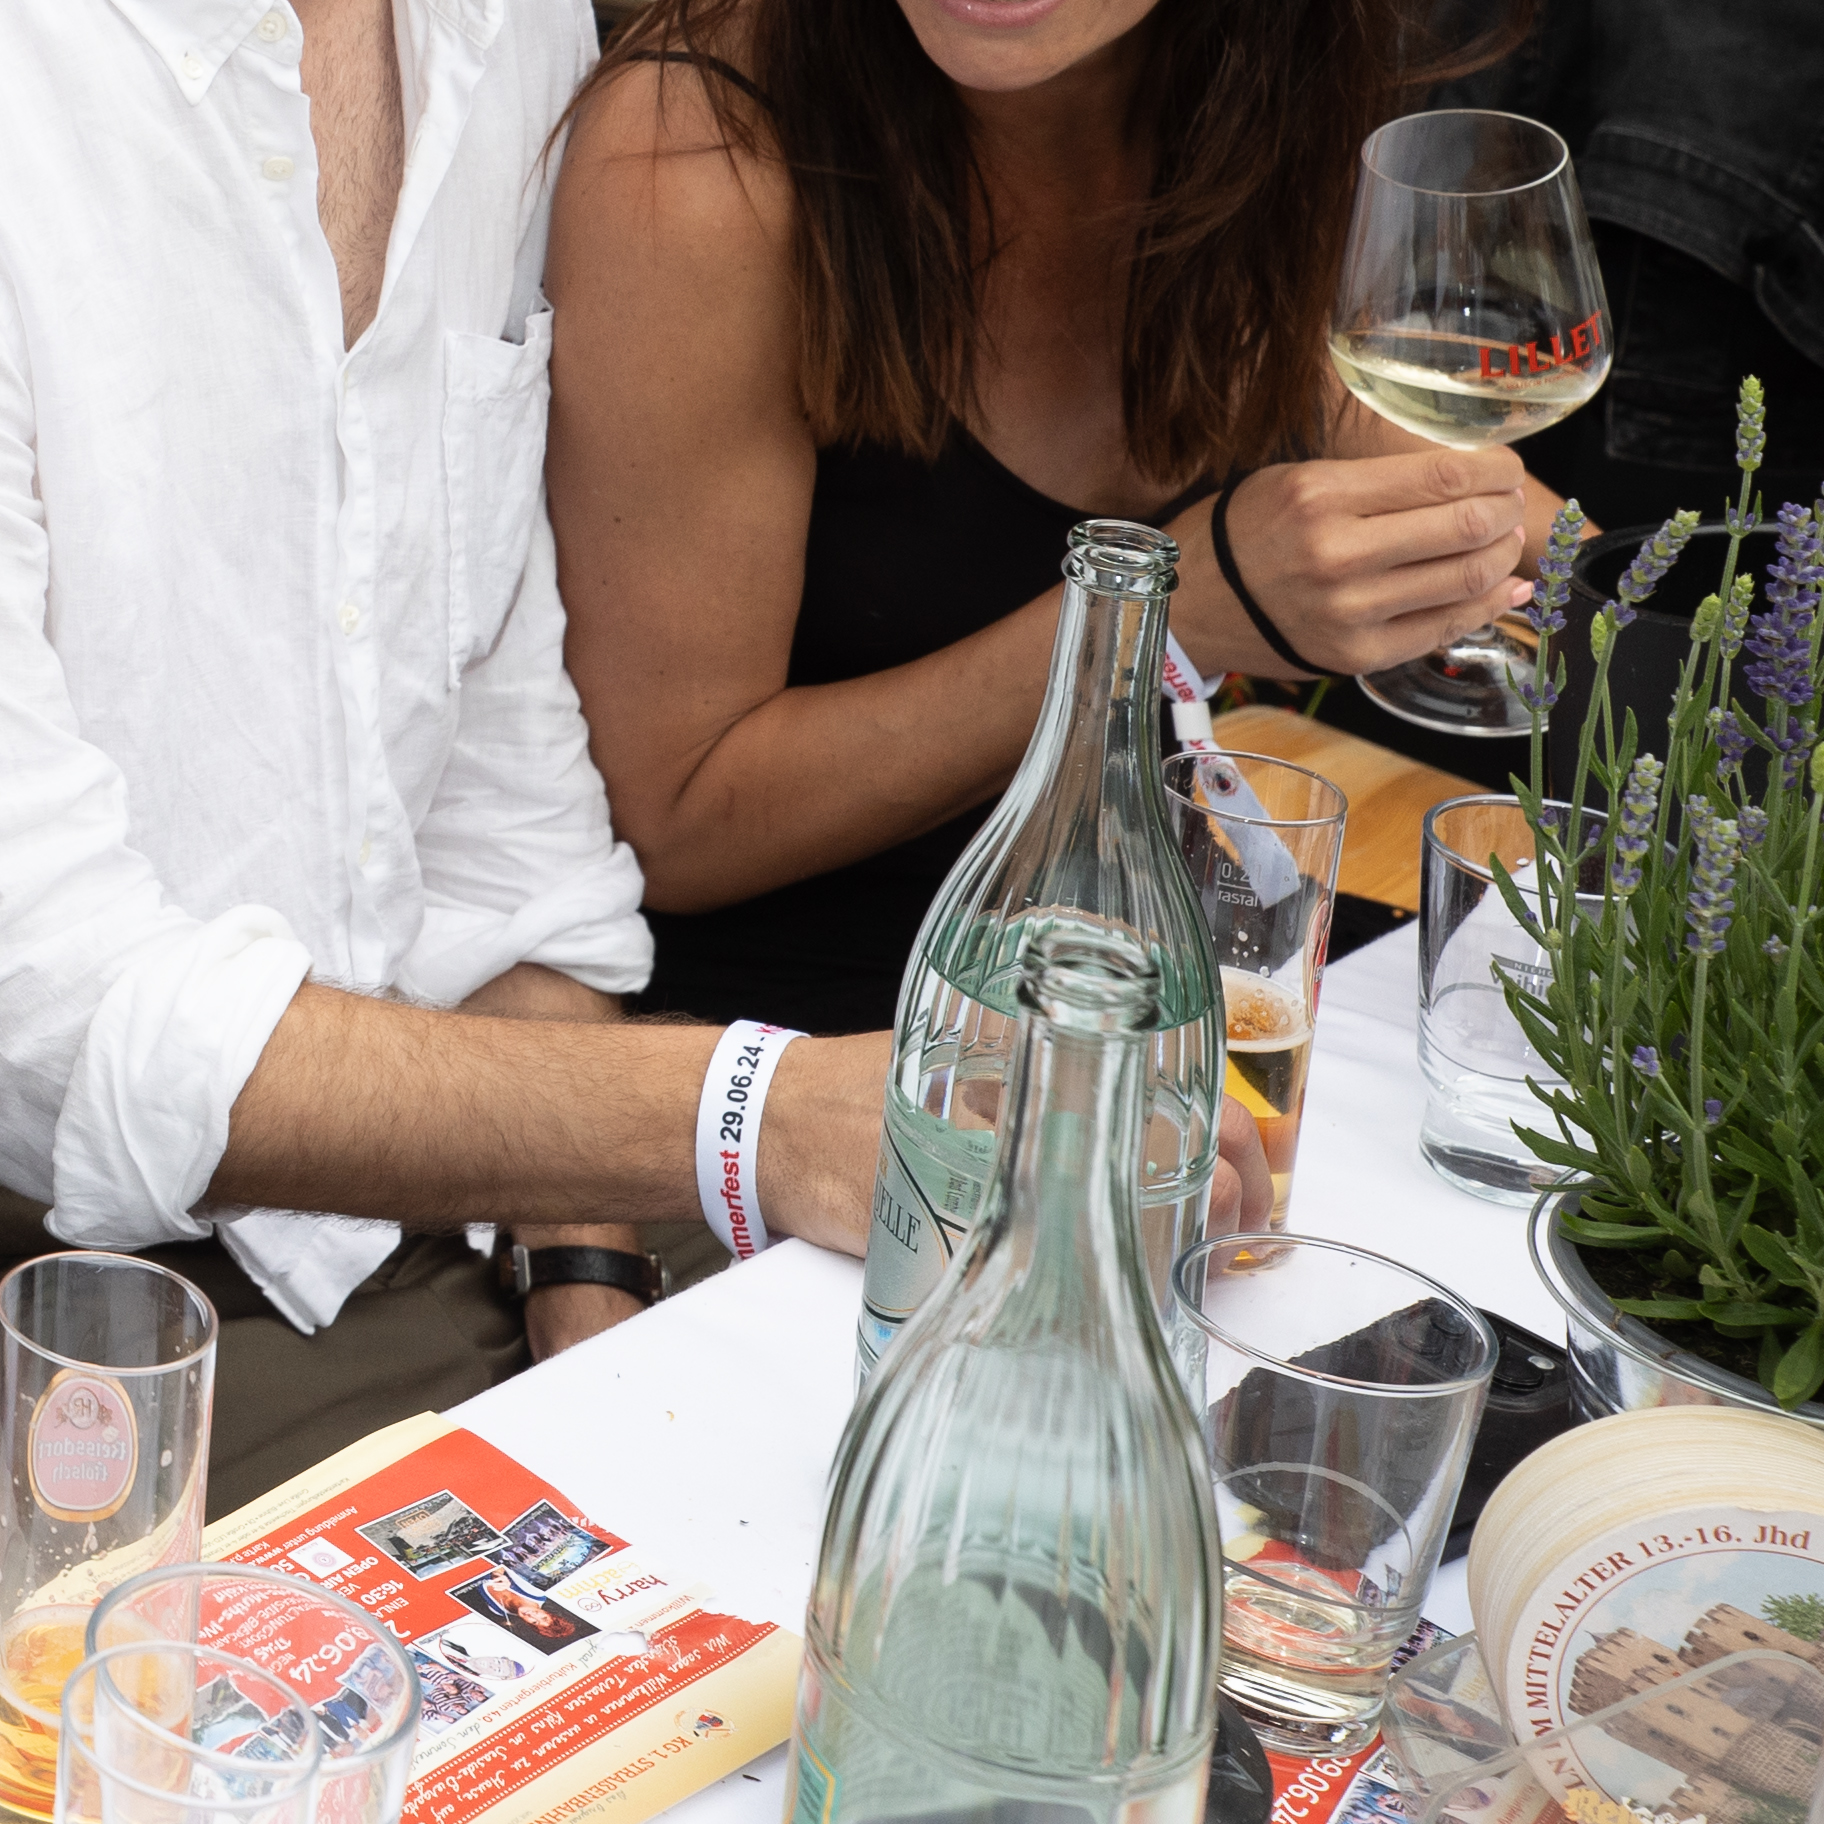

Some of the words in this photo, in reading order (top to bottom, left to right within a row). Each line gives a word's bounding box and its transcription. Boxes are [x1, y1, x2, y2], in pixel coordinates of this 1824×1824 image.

[1479, 309, 1602, 378] LILLET
[720, 1045, 764, 1143] 29.06.24
[873, 1179, 921, 1254] UELLE
[304, 1503, 358, 1538] Anmeldung
[240, 1539, 270, 1558] Karte
[280, 1532, 308, 1550] unter
[342, 1555, 378, 1578] OPEN
[359, 1576, 404, 1606] 16:30
[596, 1566, 668, 1608] harry
[1525, 1550, 1636, 1709] MITTELALTER
[1637, 1524, 1743, 1558] 13.-16.
[1753, 1525, 1812, 1551] Jhd
[662, 1640, 702, 1672] sagen
[702, 1634, 733, 1655] Wir
[496, 1659, 577, 1712] Kulturbiergarten
[562, 1670, 628, 1717] Terrassen
[598, 1670, 672, 1722] Willkommen
[526, 1707, 566, 1739] Kölns
[582, 1714, 602, 1728] in
[507, 1732, 530, 1751] im
[530, 1723, 583, 1760] unserem
[662, 1734, 691, 1754] KG
[508, 1754, 531, 1775] zu
[455, 1767, 510, 1811] Hause,
[427, 1797, 458, 1824] auf
